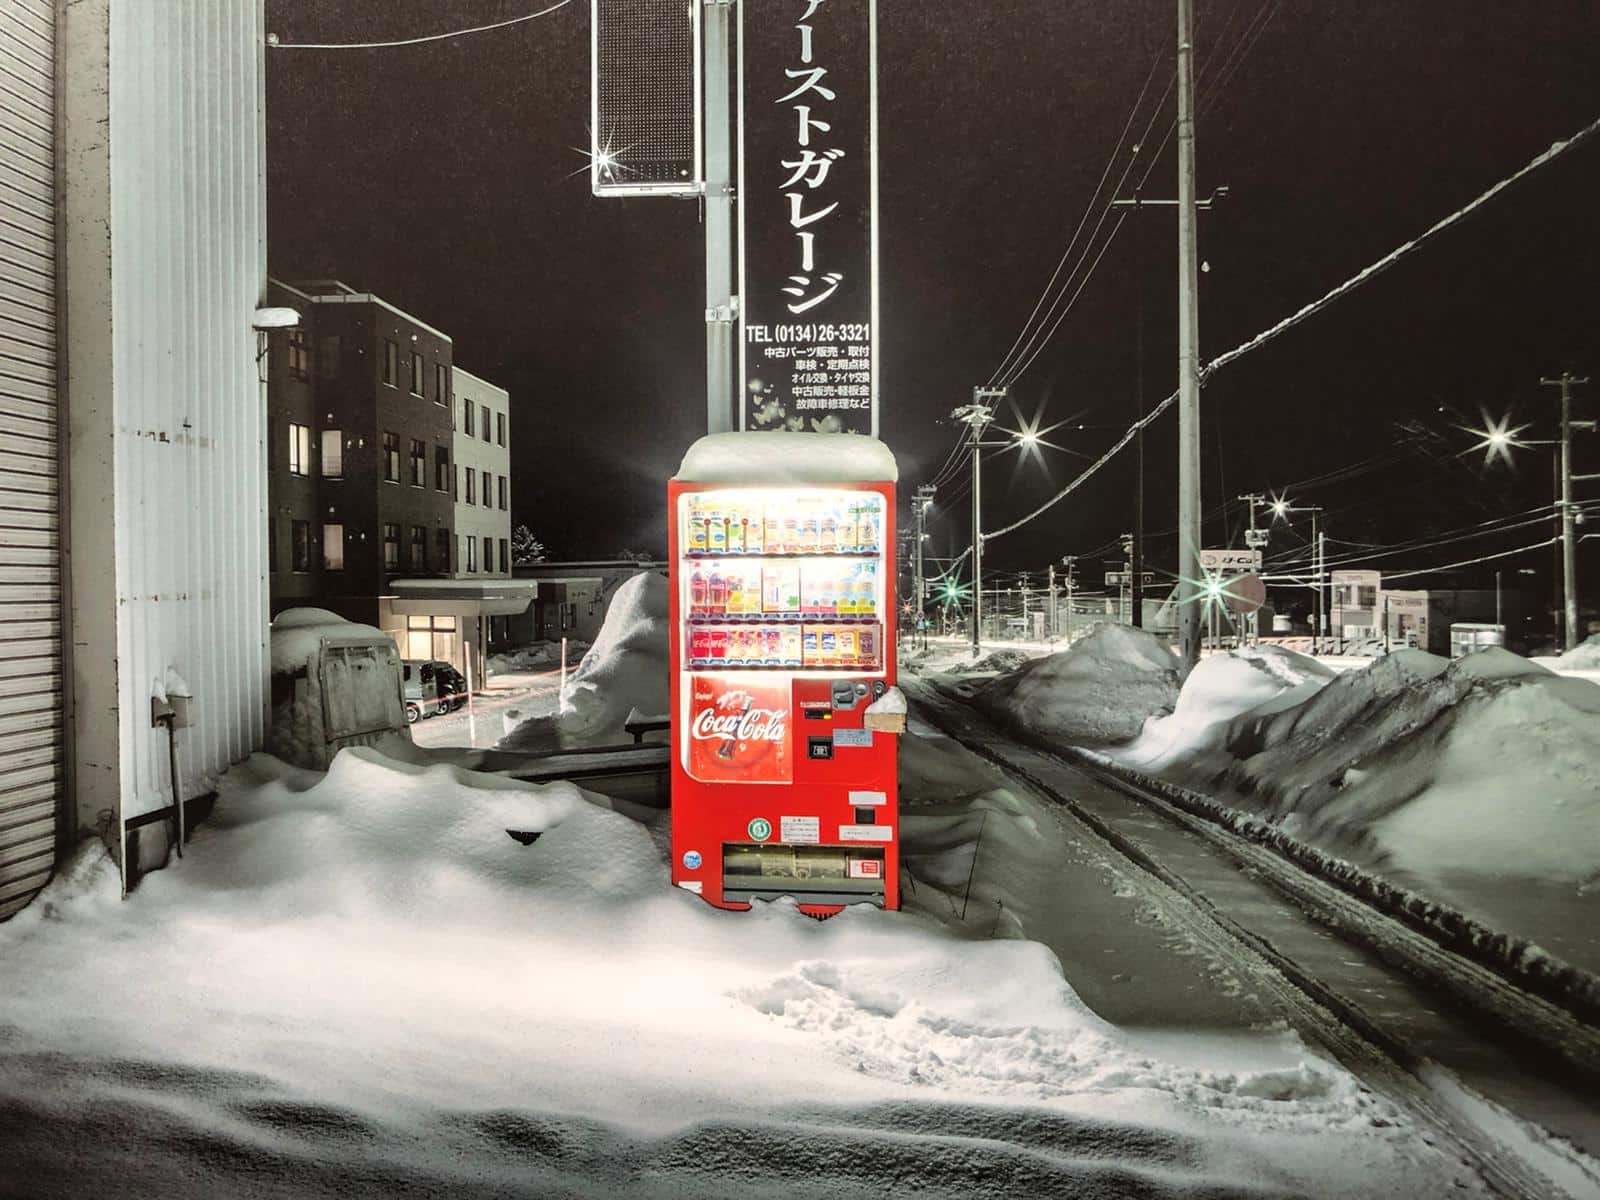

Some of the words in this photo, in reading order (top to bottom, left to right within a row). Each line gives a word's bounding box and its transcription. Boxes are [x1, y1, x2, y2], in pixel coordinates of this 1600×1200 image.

[746, 325, 773, 342] TEL
[765, 345, 869, 358] 中古パーツ販売・取付
[796, 359, 870, 370] 車検・定期点検
[792, 372, 870, 383] オイル交換・タイヤ交換
[796, 398, 869, 409] 故障車修理など
[692, 708, 787, 741] Coca-Cola
